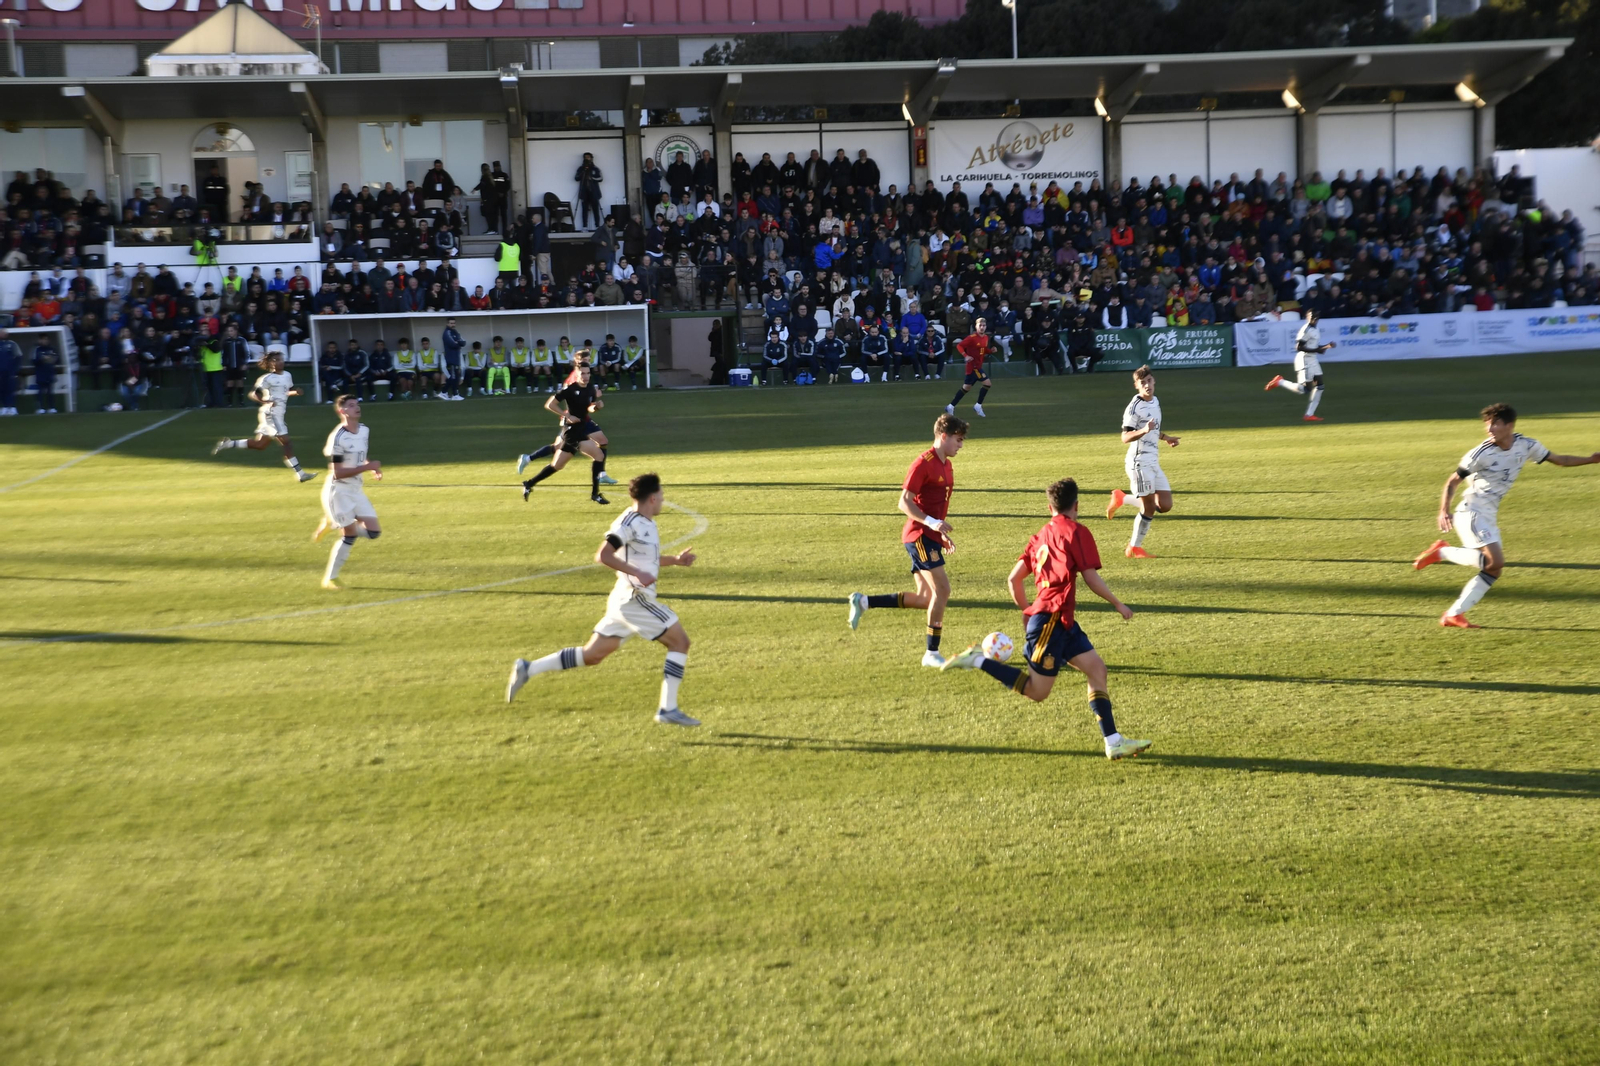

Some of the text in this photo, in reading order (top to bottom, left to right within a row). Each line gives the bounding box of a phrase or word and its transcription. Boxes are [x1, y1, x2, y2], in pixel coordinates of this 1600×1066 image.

[966, 122, 1075, 170] Atrévete
[940, 173, 953, 182] LA
[956, 173, 1012, 182] CARIHUELA
[1021, 170, 1099, 181] TORREMOLINOS
[1186, 330, 1218, 338] FRUTAS
[1148, 345, 1223, 360] Manantiales
